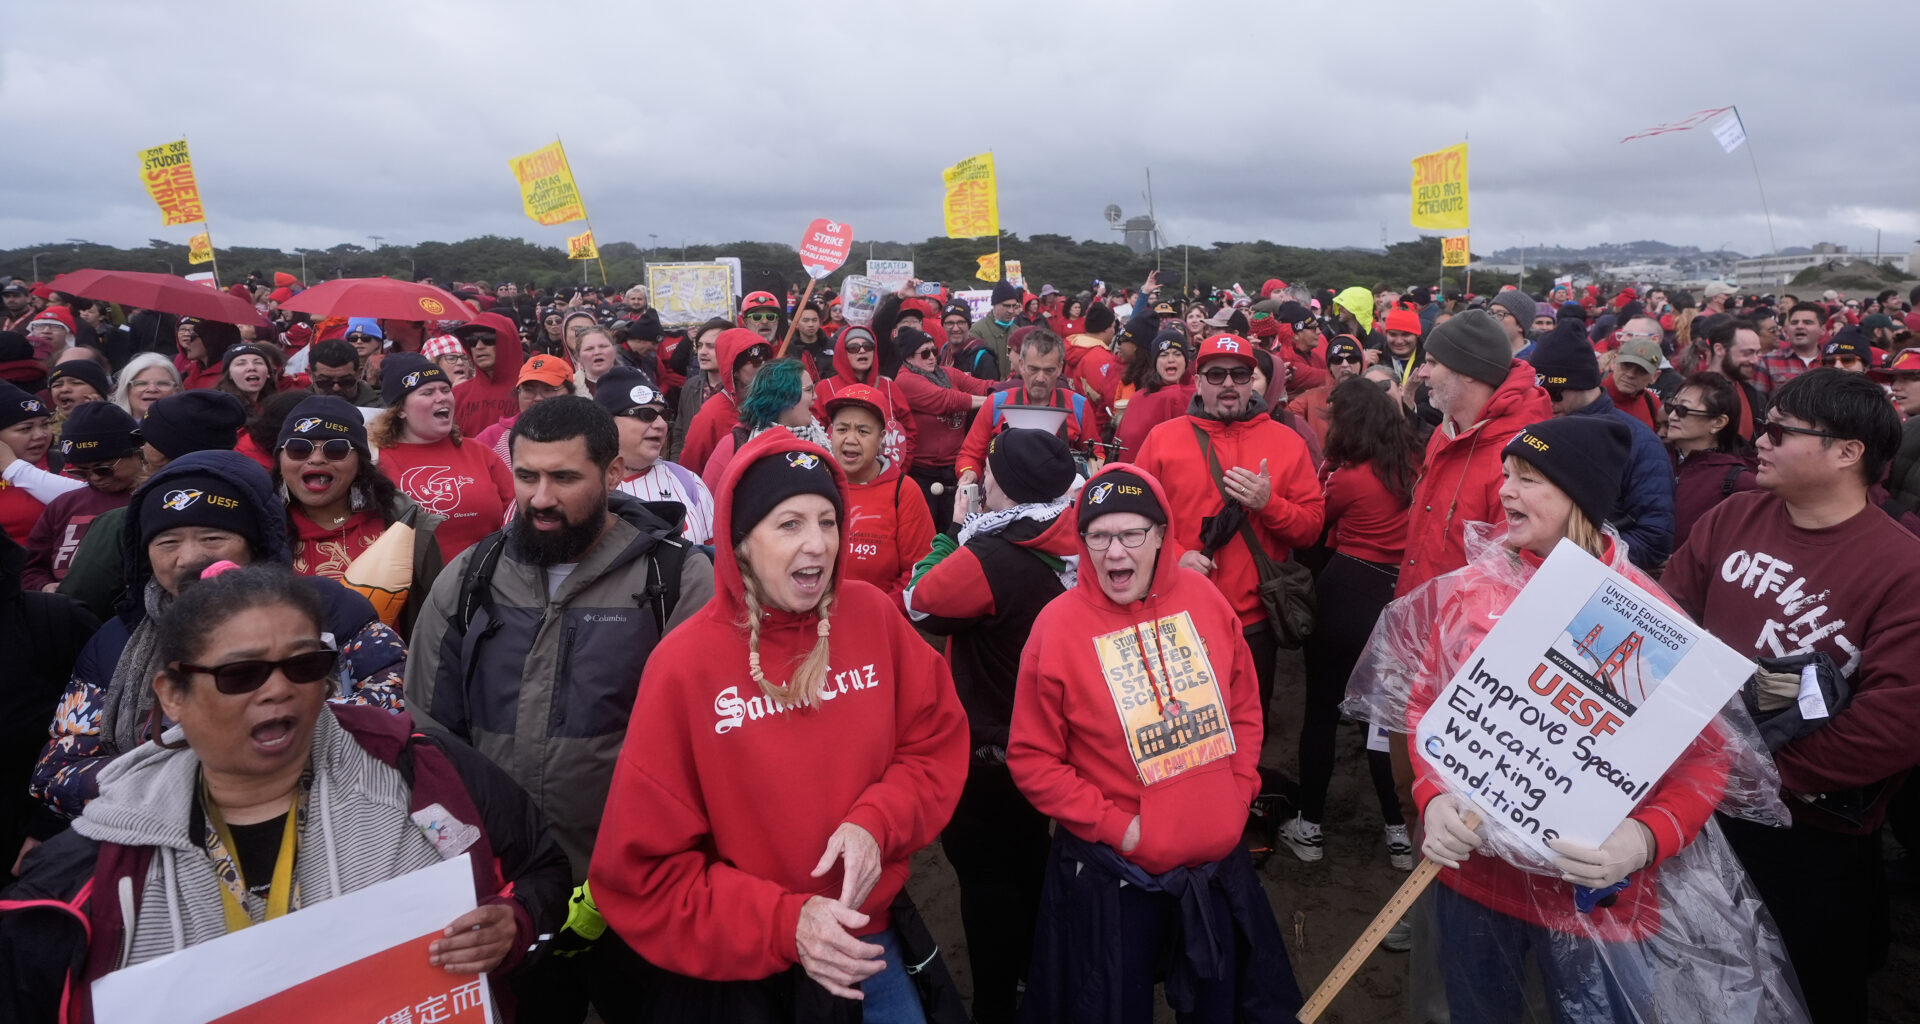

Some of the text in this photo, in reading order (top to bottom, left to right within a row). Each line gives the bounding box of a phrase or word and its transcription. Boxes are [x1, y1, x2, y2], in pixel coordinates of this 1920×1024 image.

[148, 168, 183, 226] STRIKE
[170, 164, 204, 223] HUELGA
[826, 223, 842, 233] ON
[813, 232, 845, 247] STRIKE
[800, 250, 843, 264] STABLE SCHOOLS
[806, 244, 818, 252] FOR
[830, 249, 842, 257] AND
[422, 369, 440, 377] UESF
[325, 421, 349, 433] UESF
[76, 441, 99, 449] UESF
[1522, 433, 1549, 453] UESF
[1117, 484, 1142, 495] UESF
[207, 494, 239, 509] UESF
[849, 543, 877, 556] 1493
[592, 614, 627, 622] Columbia
[1606, 585, 1689, 645] UNITED EDUCATORS
[1613, 602, 1632, 619] SAN
[1631, 616, 1680, 651] FRANCISCO
[1552, 655, 1574, 672] AFT/CFT
[1527, 662, 1625, 738] UESF
[1468, 656, 1650, 802] Improve Special
[1448, 684, 1573, 795] Education
[1143, 736, 1229, 782] WE CAN'T WAIT!
[1445, 717, 1547, 811] Working
